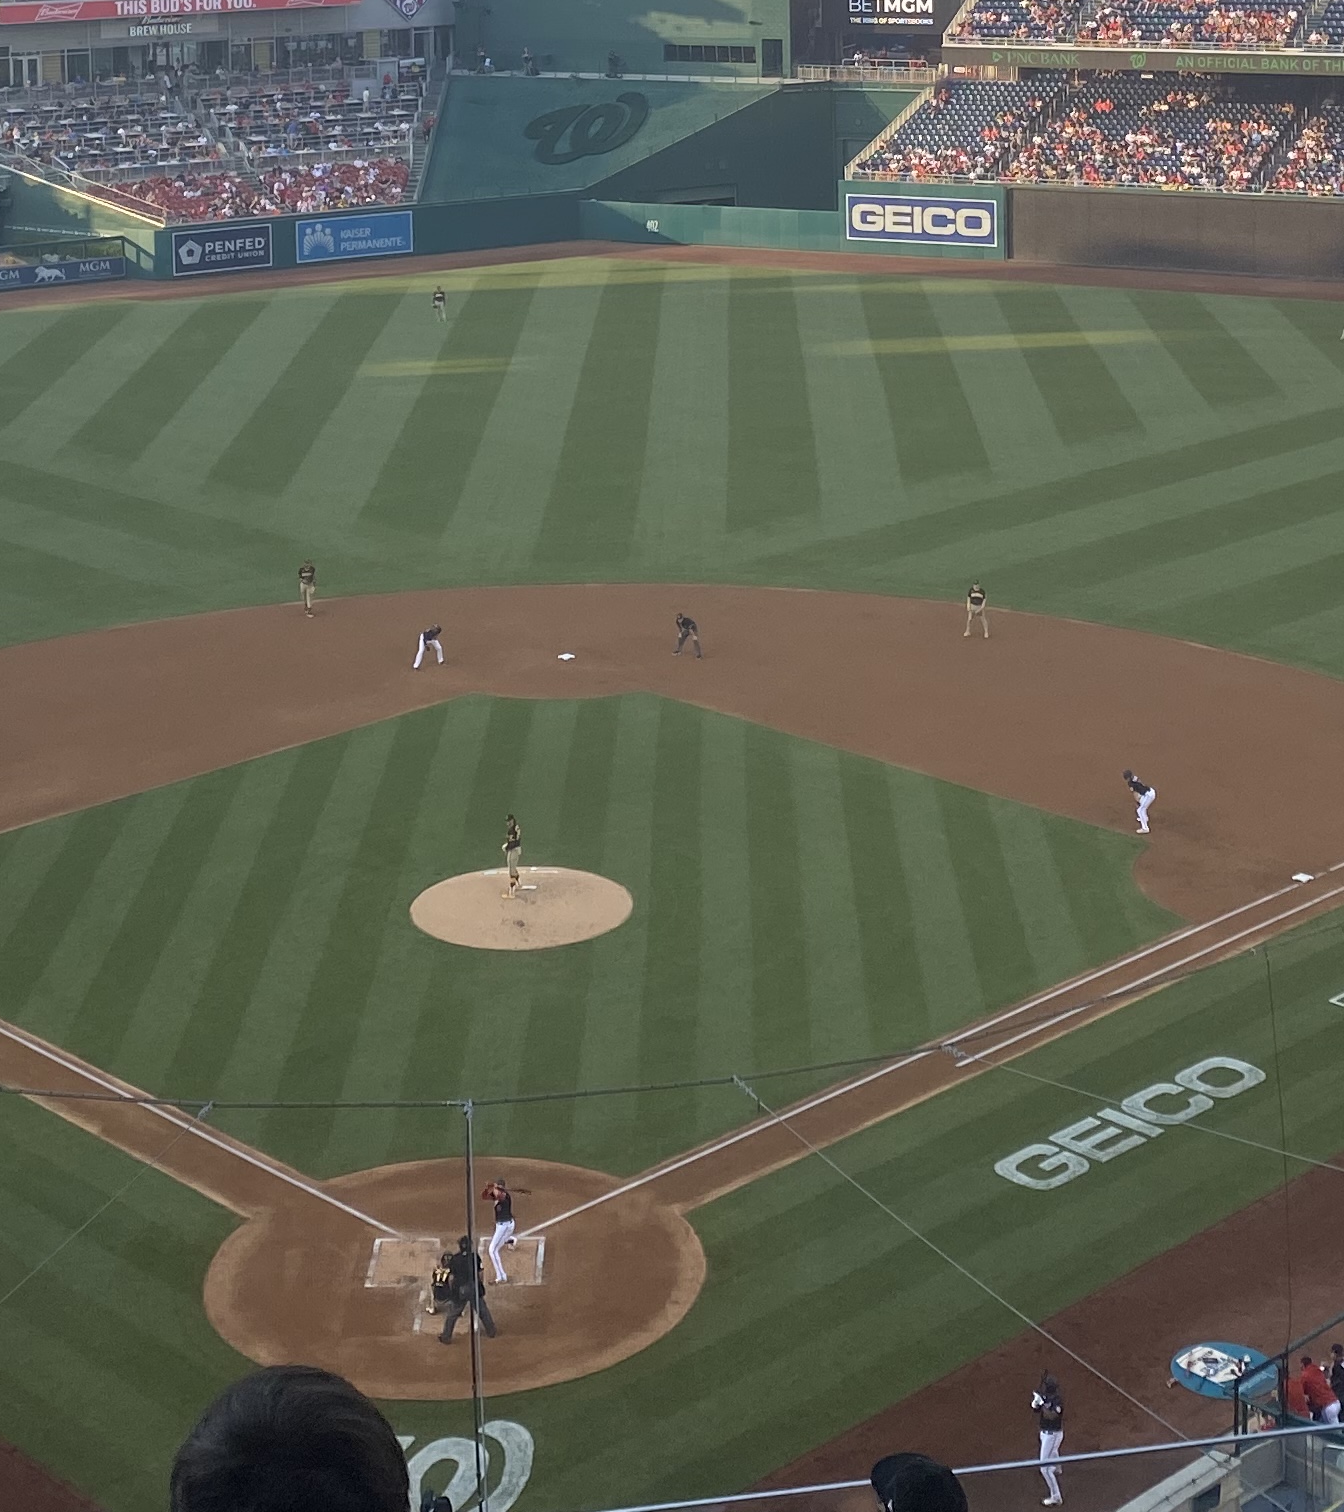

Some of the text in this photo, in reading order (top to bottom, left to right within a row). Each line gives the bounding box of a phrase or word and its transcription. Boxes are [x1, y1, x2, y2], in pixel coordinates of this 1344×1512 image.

[114, 0, 148, 16] THIS
[129, 22, 192, 37] BREW HOUSE
[1175, 55, 1194, 67] AN
[1197, 55, 1255, 69] OFFICIAL
[1261, 57, 1299, 71] BANK
[1302, 58, 1320, 71] OF
[852, 203, 991, 237] GEICO
[340, 227, 371, 238] KAISER
[205, 236, 266, 254] PENFED
[340, 236, 403, 251] PERMANENTE
[205, 249, 265, 262] CREDIT UNION
[79, 260, 111, 273] MGM
[994, 1056, 1266, 1190] GEICO
